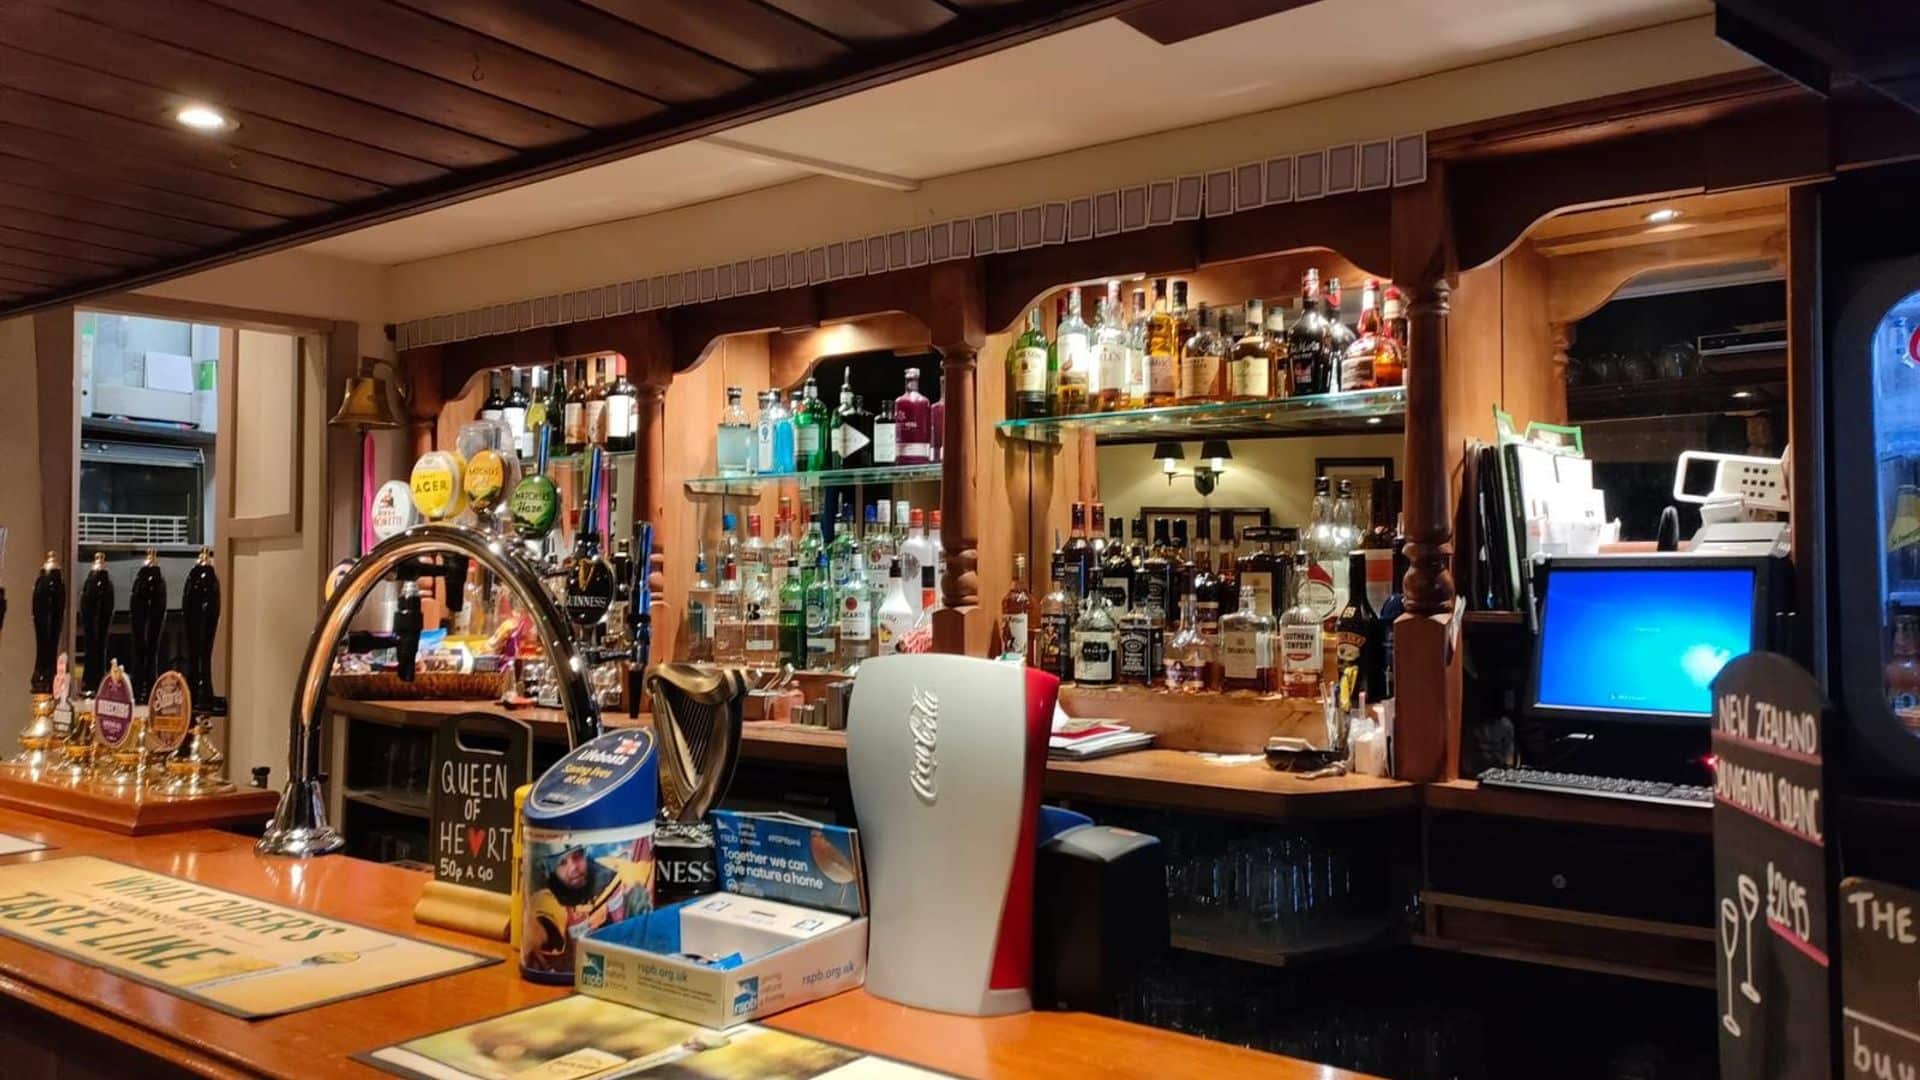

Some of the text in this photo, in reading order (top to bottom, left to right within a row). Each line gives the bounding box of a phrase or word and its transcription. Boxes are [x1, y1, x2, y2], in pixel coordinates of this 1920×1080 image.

[414, 480, 450, 494] AGER
[1718, 694, 1818, 755] NEW ZEALAND
[441, 760, 508, 801] QUEEN
[464, 799, 481, 821] OF
[1777, 777, 1823, 840] BLANC
[440, 857, 463, 882] 50p
[466, 864, 475, 880] A
[721, 846, 808, 873] Together we can
[92, 874, 216, 906] WHAT
[723, 861, 746, 877] give
[746, 866, 782, 883] nature
[791, 871, 824, 890] home
[1848, 891, 1918, 944] THE
[77, 927, 238, 970] LIKE
[801, 960, 855, 986] rspb.org.uk
